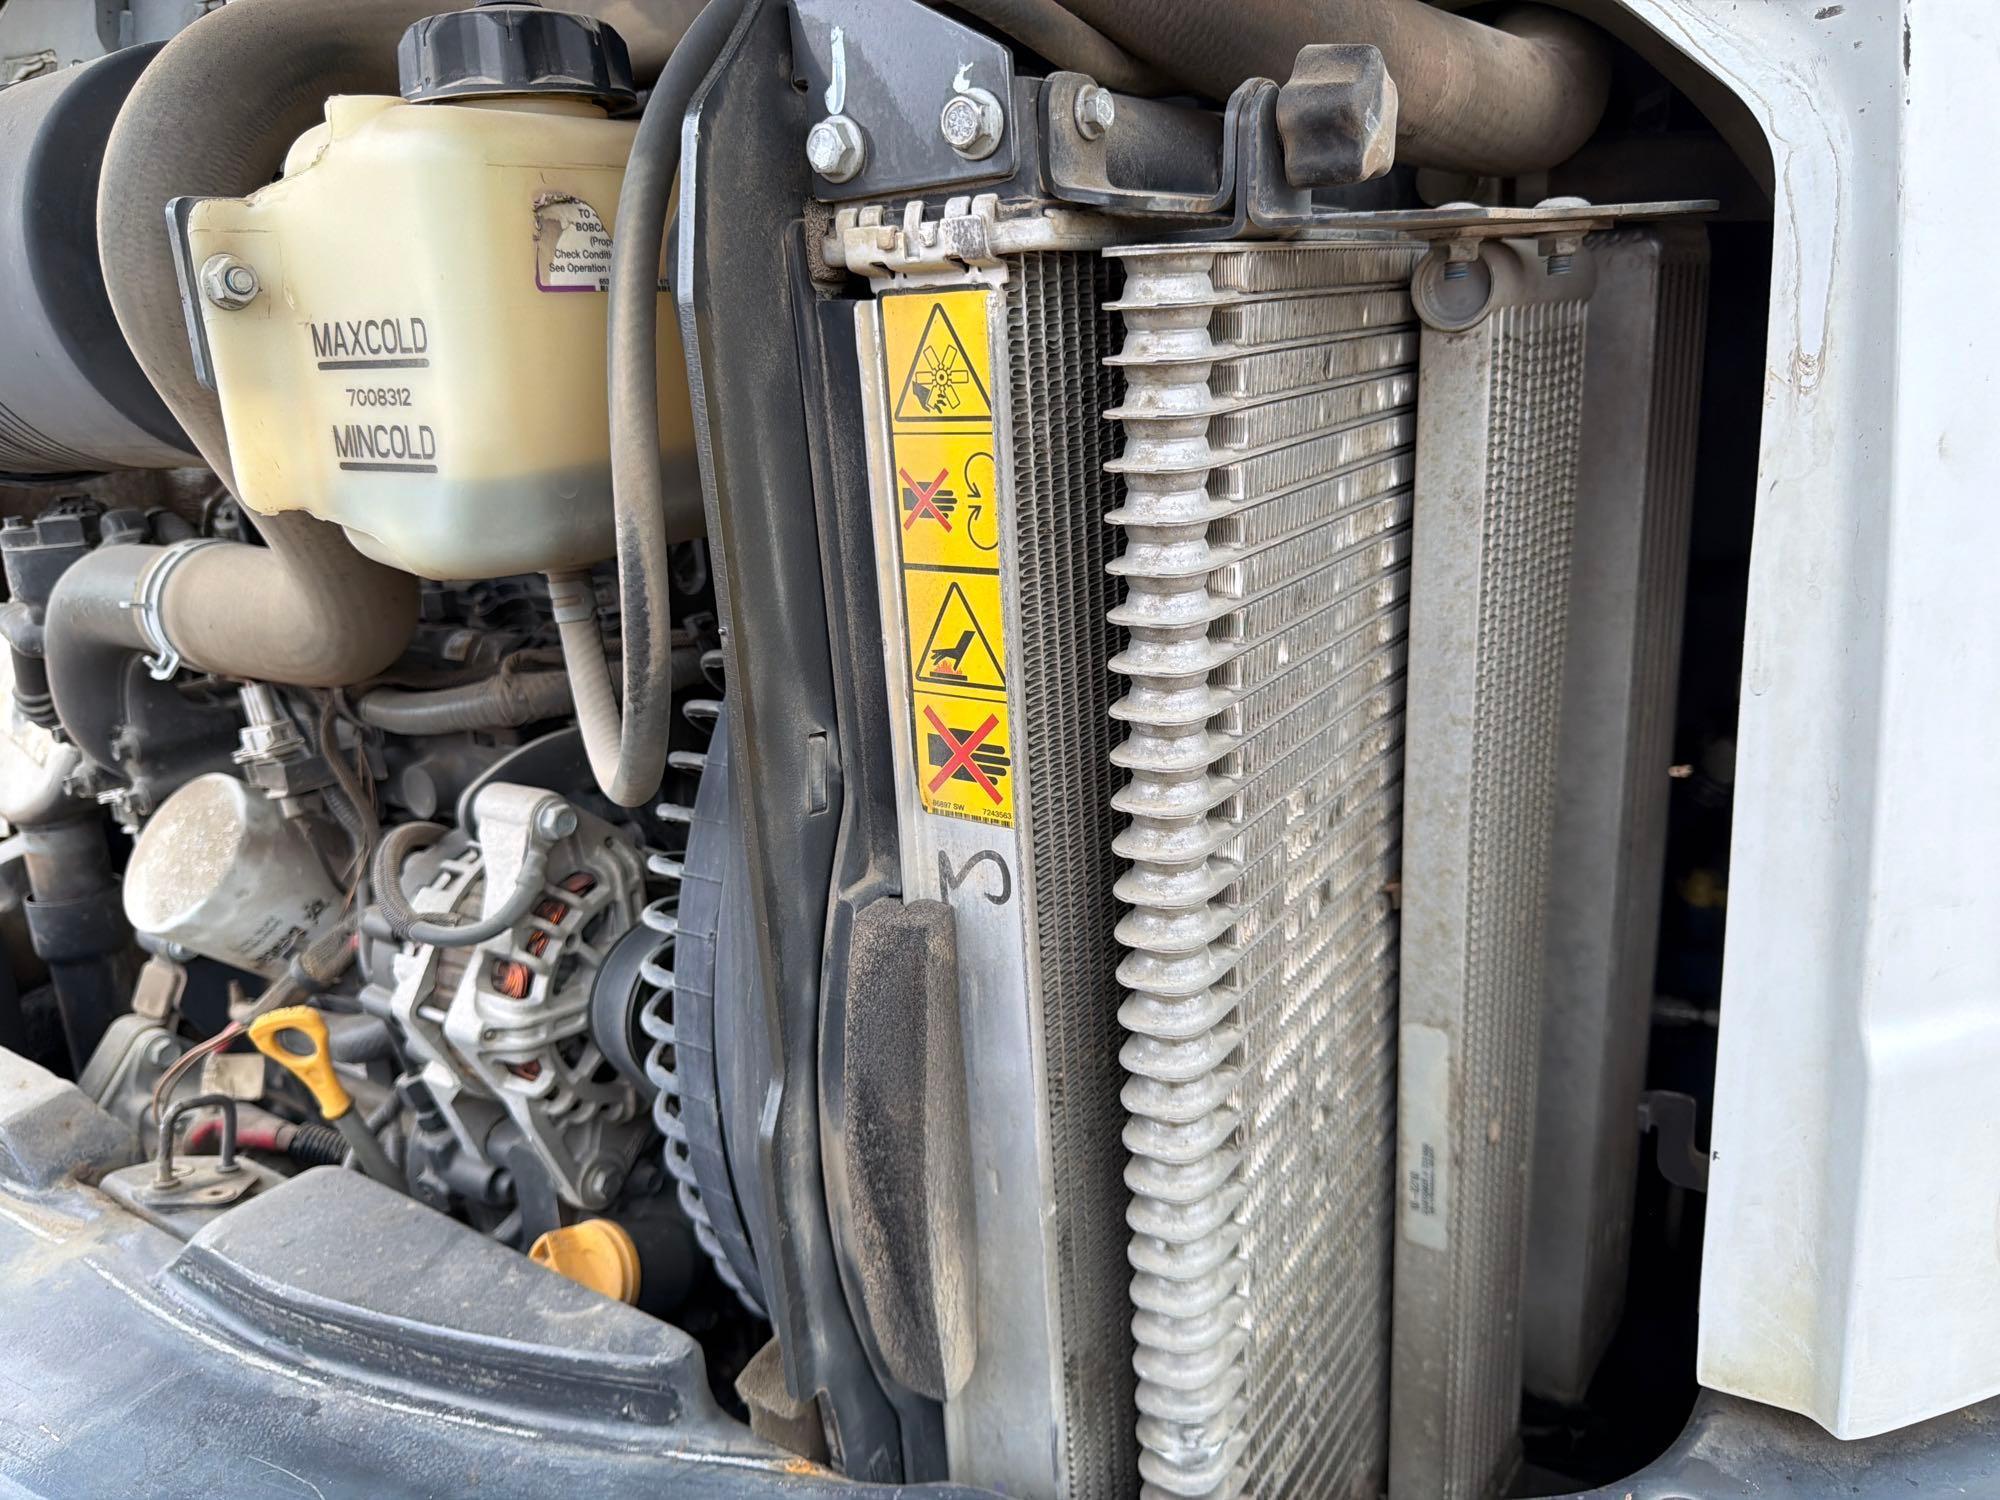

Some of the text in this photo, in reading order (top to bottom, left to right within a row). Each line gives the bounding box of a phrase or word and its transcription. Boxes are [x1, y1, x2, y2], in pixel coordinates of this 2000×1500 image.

[554, 249, 581, 260] Check
[549, 262, 607, 275] See Operation
[311, 317, 428, 357] MAXCOLD
[345, 388, 412, 406] 7008312
[332, 424, 436, 460] MINCOLD
